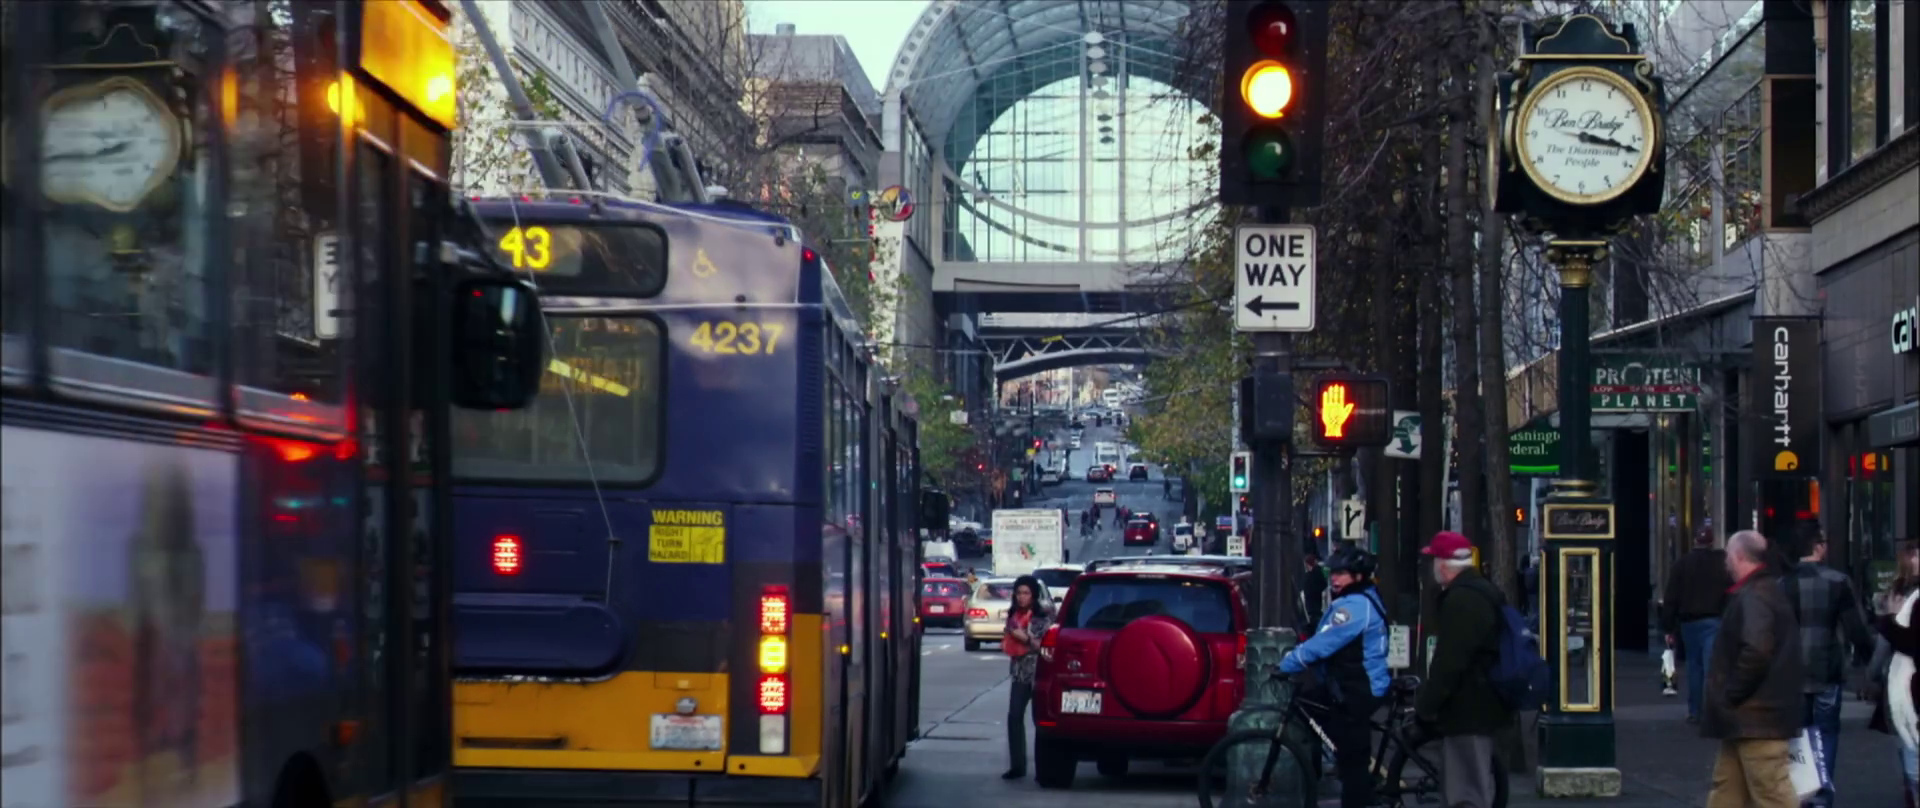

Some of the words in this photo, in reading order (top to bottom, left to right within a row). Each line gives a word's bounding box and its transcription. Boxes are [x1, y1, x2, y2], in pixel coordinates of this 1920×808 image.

[1556, 89, 1567, 98] 11
[1580, 83, 1592, 91] 12
[1544, 108, 1577, 129] Ben
[1577, 109, 1625, 137] Bridge
[1546, 144, 1565, 154] The
[1567, 145, 1620, 157] Diamond
[1564, 157, 1601, 169] People
[500, 226, 550, 268] 43
[1245, 233, 1304, 257] ONE
[1244, 263, 1306, 286] WAY
[691, 321, 784, 354] 4237
[1595, 361, 1693, 385] PROTEIN
[1593, 385, 1614, 393] LOW
[1774, 326, 1793, 448] carhartt
[1601, 394, 1687, 407] PLANET
[651, 510, 723, 525] WARNING
[656, 538, 683, 548] TURN
